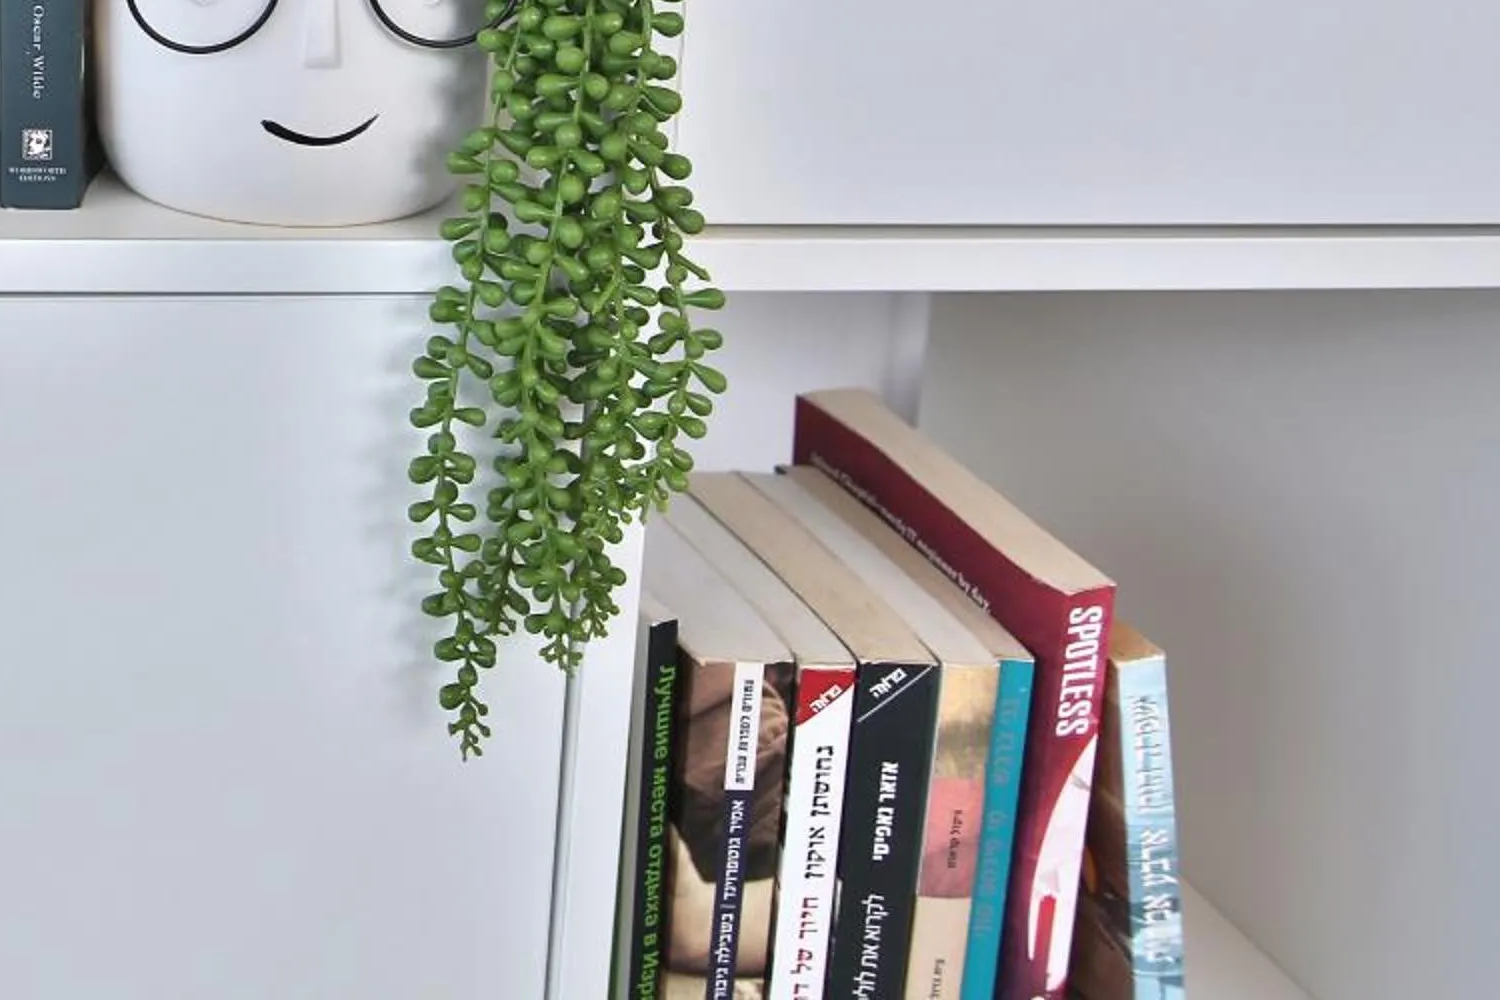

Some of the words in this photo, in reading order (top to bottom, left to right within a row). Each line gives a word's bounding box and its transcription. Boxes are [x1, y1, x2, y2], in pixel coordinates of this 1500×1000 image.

[32, 4, 44, 50] Oscar
[32, 56, 44, 99] Wilde
[1054, 605, 1103, 738] SPOTLESS
[653, 665, 677, 760] Лучшие
[648, 767, 666, 838] места
[810, 745, 833, 817] נחושתן
[878, 762, 899, 801] אזאר
[729, 800, 744, 834] אמיר
[873, 807, 894, 861] נאפיסי
[804, 826, 826, 880] אוקון
[643, 843, 663, 926] отдыха
[644, 934, 657, 946] в
[714, 913, 735, 964] בשבילה
[798, 896, 819, 940] חיוך
[860, 894, 890, 941] לקרוא
[790, 949, 813, 975] של
[861, 944, 880, 969] את
